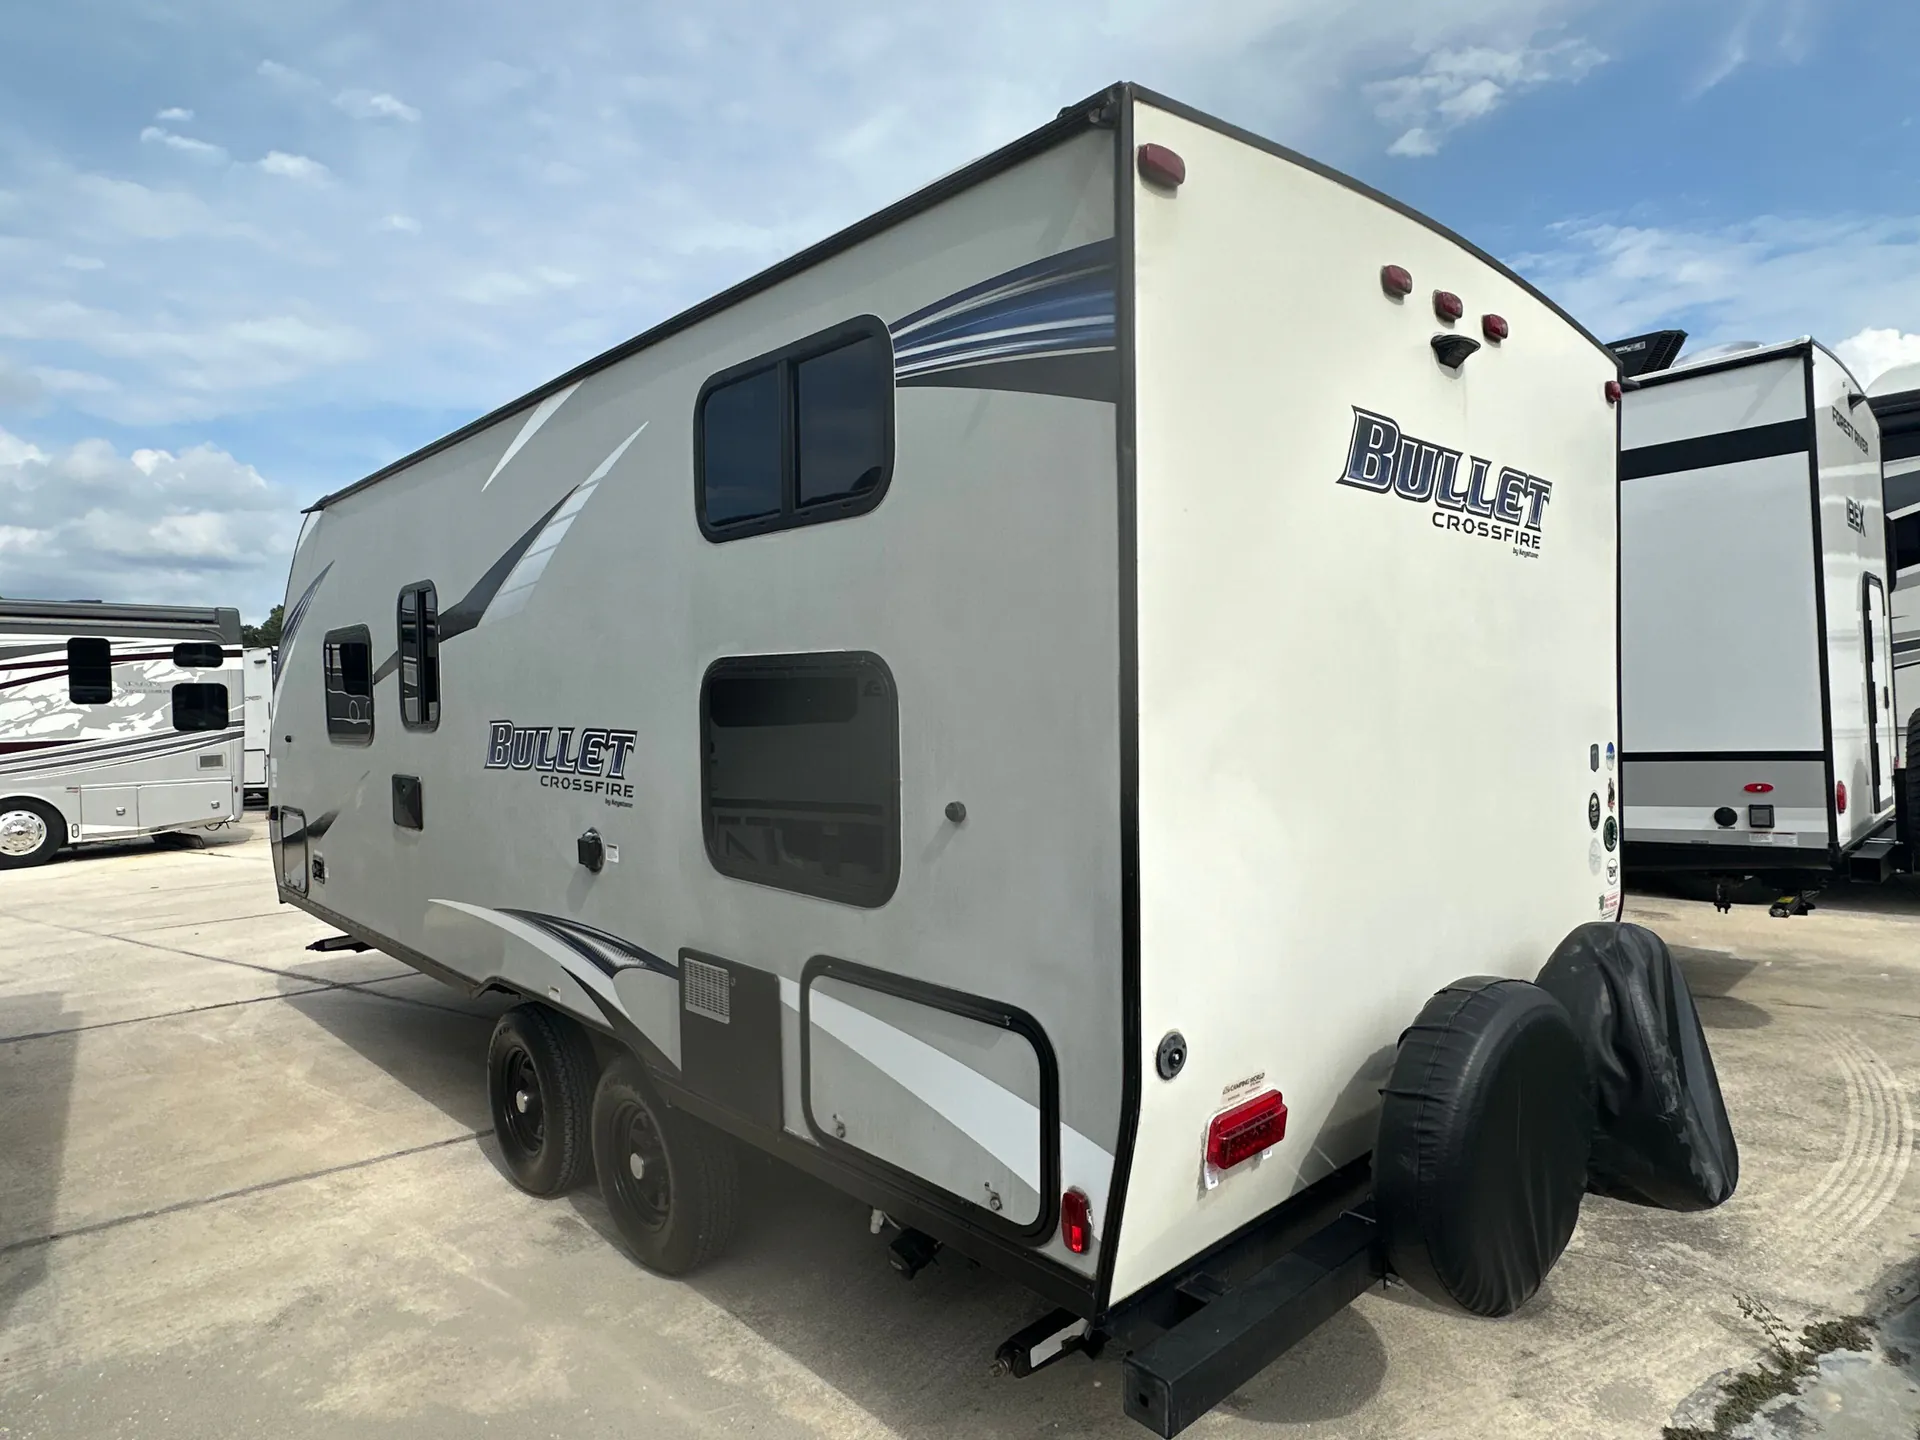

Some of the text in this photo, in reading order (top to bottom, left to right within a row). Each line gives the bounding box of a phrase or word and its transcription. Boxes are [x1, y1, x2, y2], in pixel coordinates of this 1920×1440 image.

[1831, 405, 1869, 456] FOREST RIVER
[1335, 404, 1553, 532] BULLET
[1432, 511, 1541, 550] CROSSFIRE
[484, 720, 638, 780] BULLET
[540, 775, 634, 798] CROSSFIRE
[1230, 1078, 1250, 1092] CAMPING
[1249, 1072, 1265, 1083] WORLD
